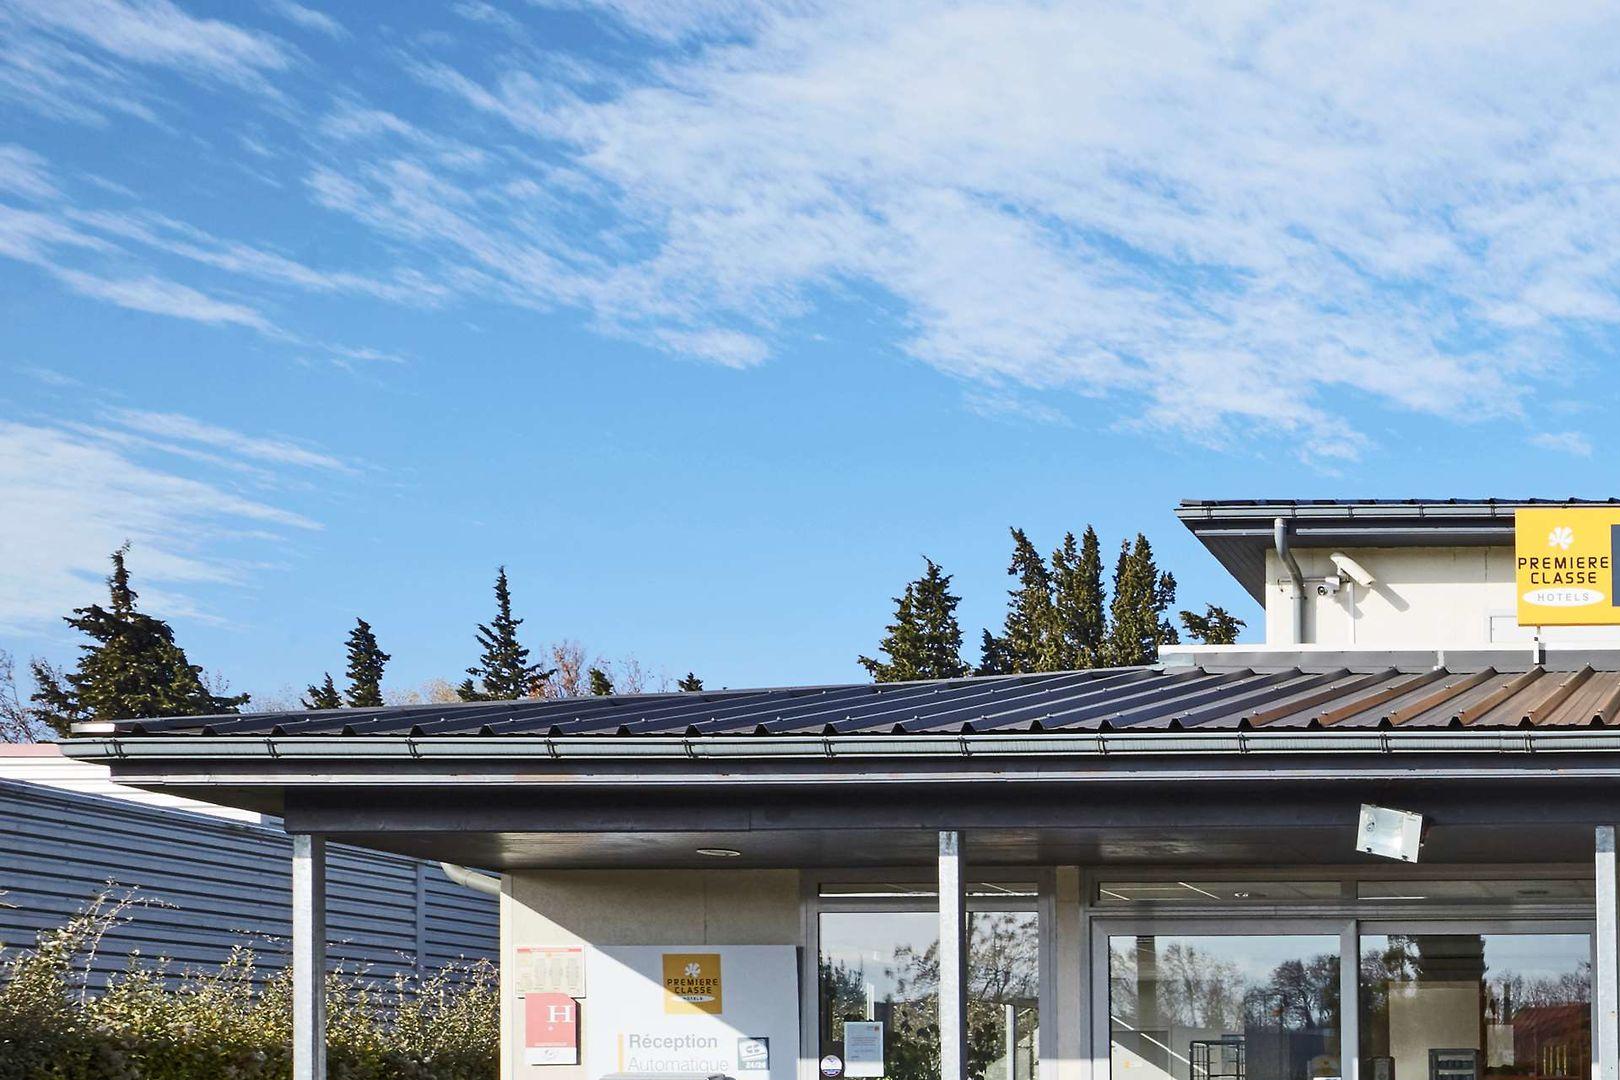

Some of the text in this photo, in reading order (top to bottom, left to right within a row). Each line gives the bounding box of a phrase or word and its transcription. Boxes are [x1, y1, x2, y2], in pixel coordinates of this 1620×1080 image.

[1517, 556, 1609, 570] PREMIERE
[1530, 571, 1597, 584] CLASSE
[1537, 592, 1590, 602] HOTELS
[666, 978, 719, 986] PREMIERE
[674, 986, 712, 994] CLASSE
[547, 1005, 575, 1023] H
[629, 1033, 718, 1051] Réception
[628, 1057, 729, 1073] Automatique
